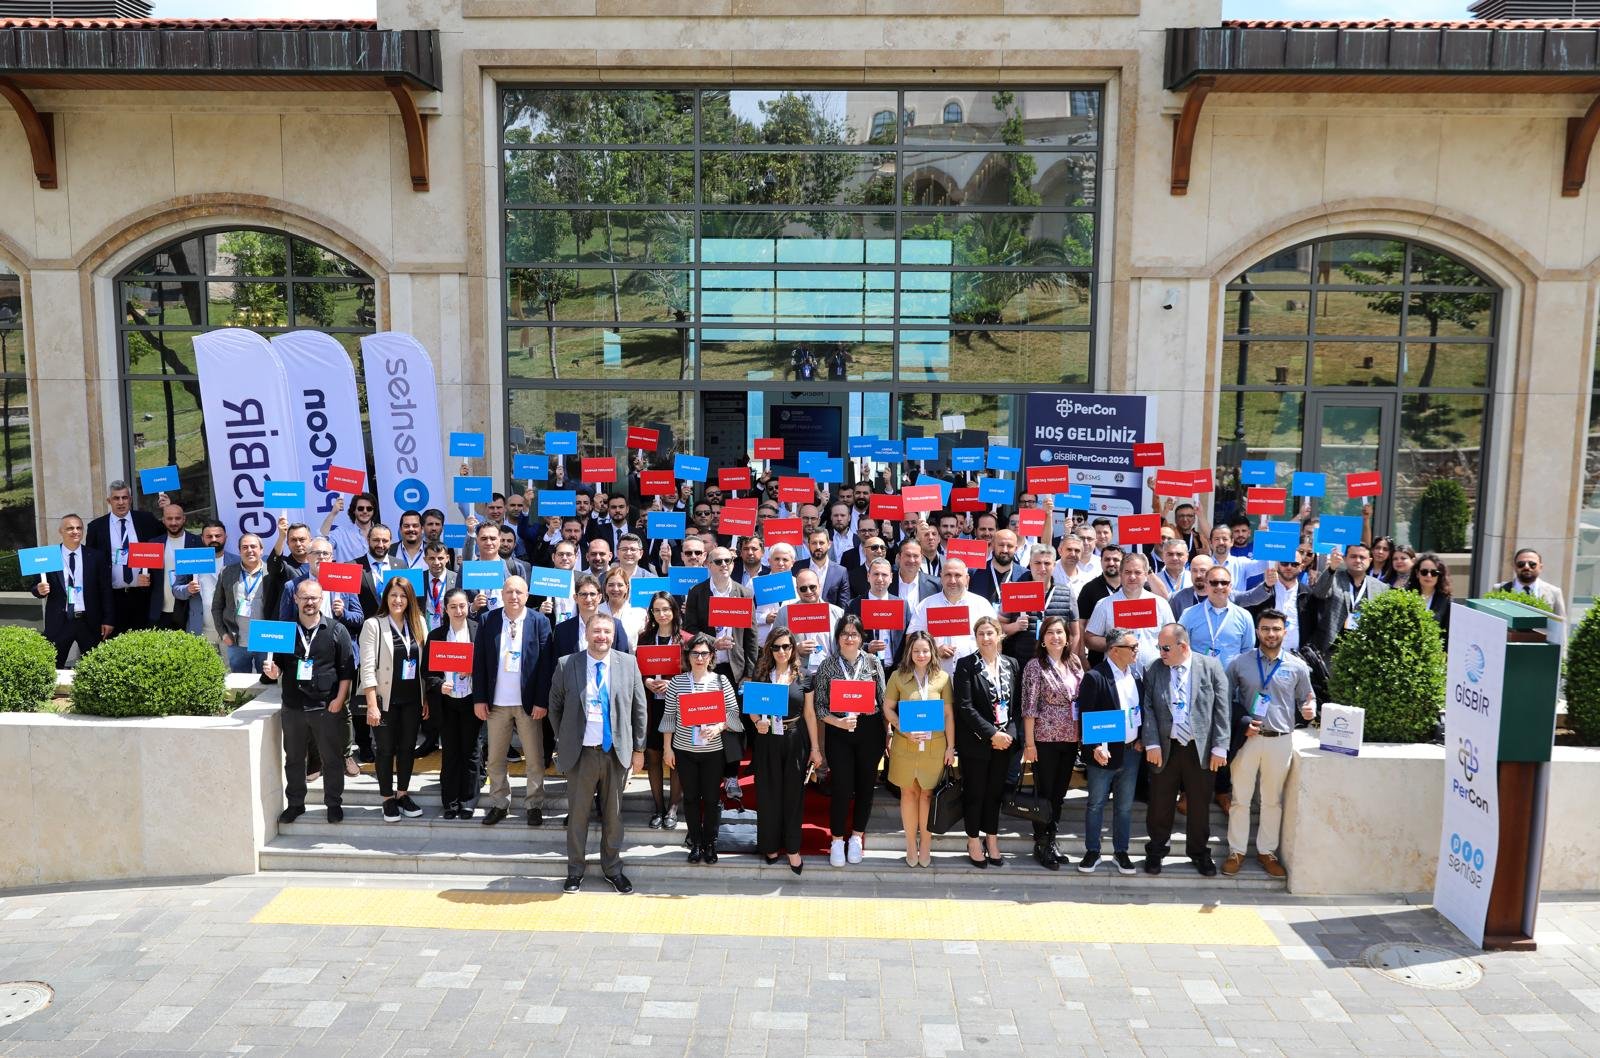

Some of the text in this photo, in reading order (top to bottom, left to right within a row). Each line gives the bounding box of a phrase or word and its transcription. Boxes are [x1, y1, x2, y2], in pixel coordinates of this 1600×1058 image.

[1074, 403, 1117, 416] PerCon
[1035, 425, 1137, 443] HOŞ GELDİNİZ
[1054, 450, 1130, 465] GİSBİR PerCon 2024
[1455, 681, 1490, 718] GİSBİR
[1453, 778, 1489, 814] PerCon
